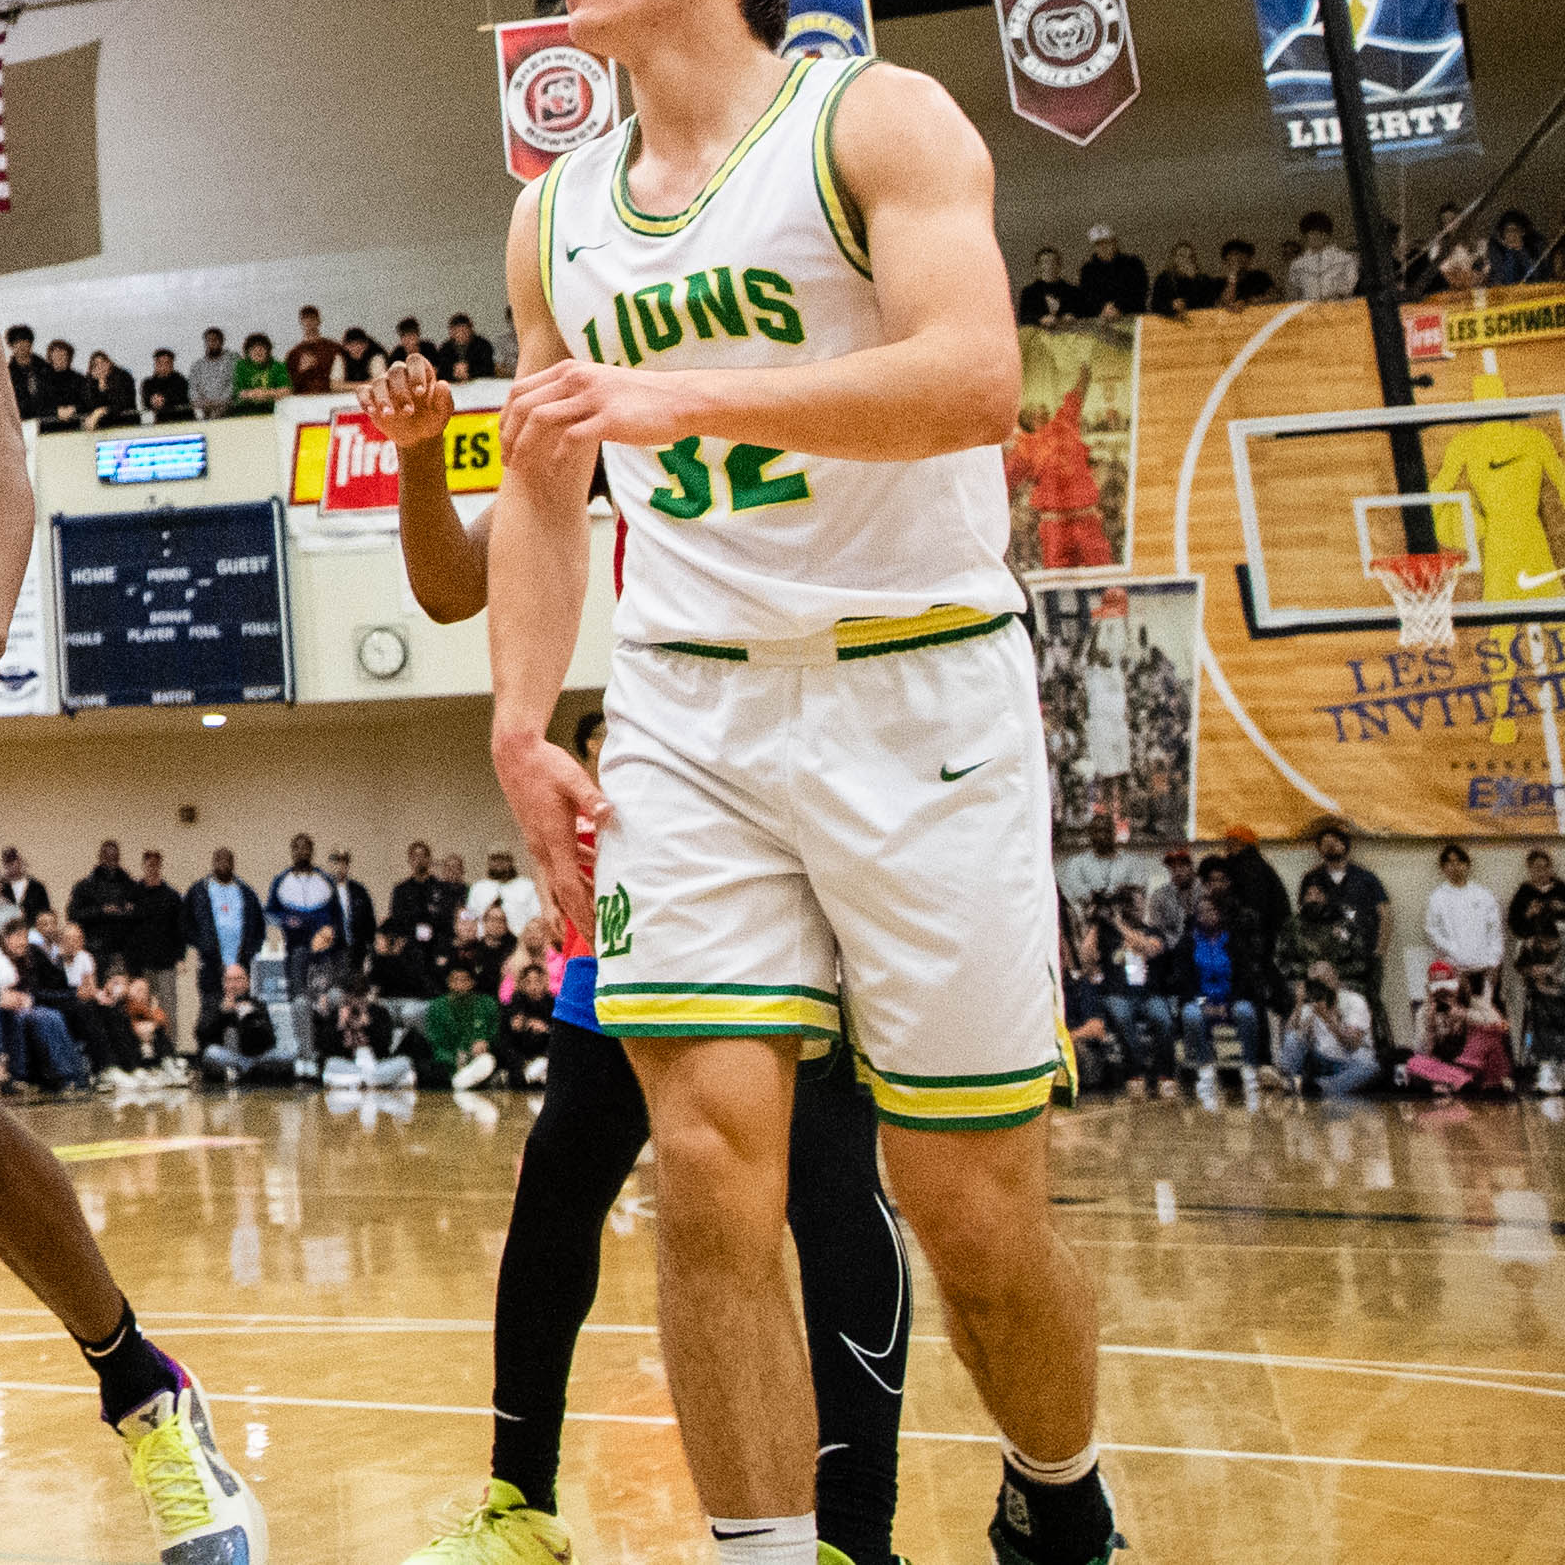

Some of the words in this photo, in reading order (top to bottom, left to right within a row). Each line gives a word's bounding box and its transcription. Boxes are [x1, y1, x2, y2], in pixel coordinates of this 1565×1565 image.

[1287, 101, 1464, 148] LIERTY
[582, 266, 807, 368] LIONS
[71, 566, 117, 585] HOME
[216, 554, 270, 575] GUEST
[126, 626, 176, 643] PLAYER
[188, 624, 220, 639] FOUL
[1347, 647, 1456, 694] LES
